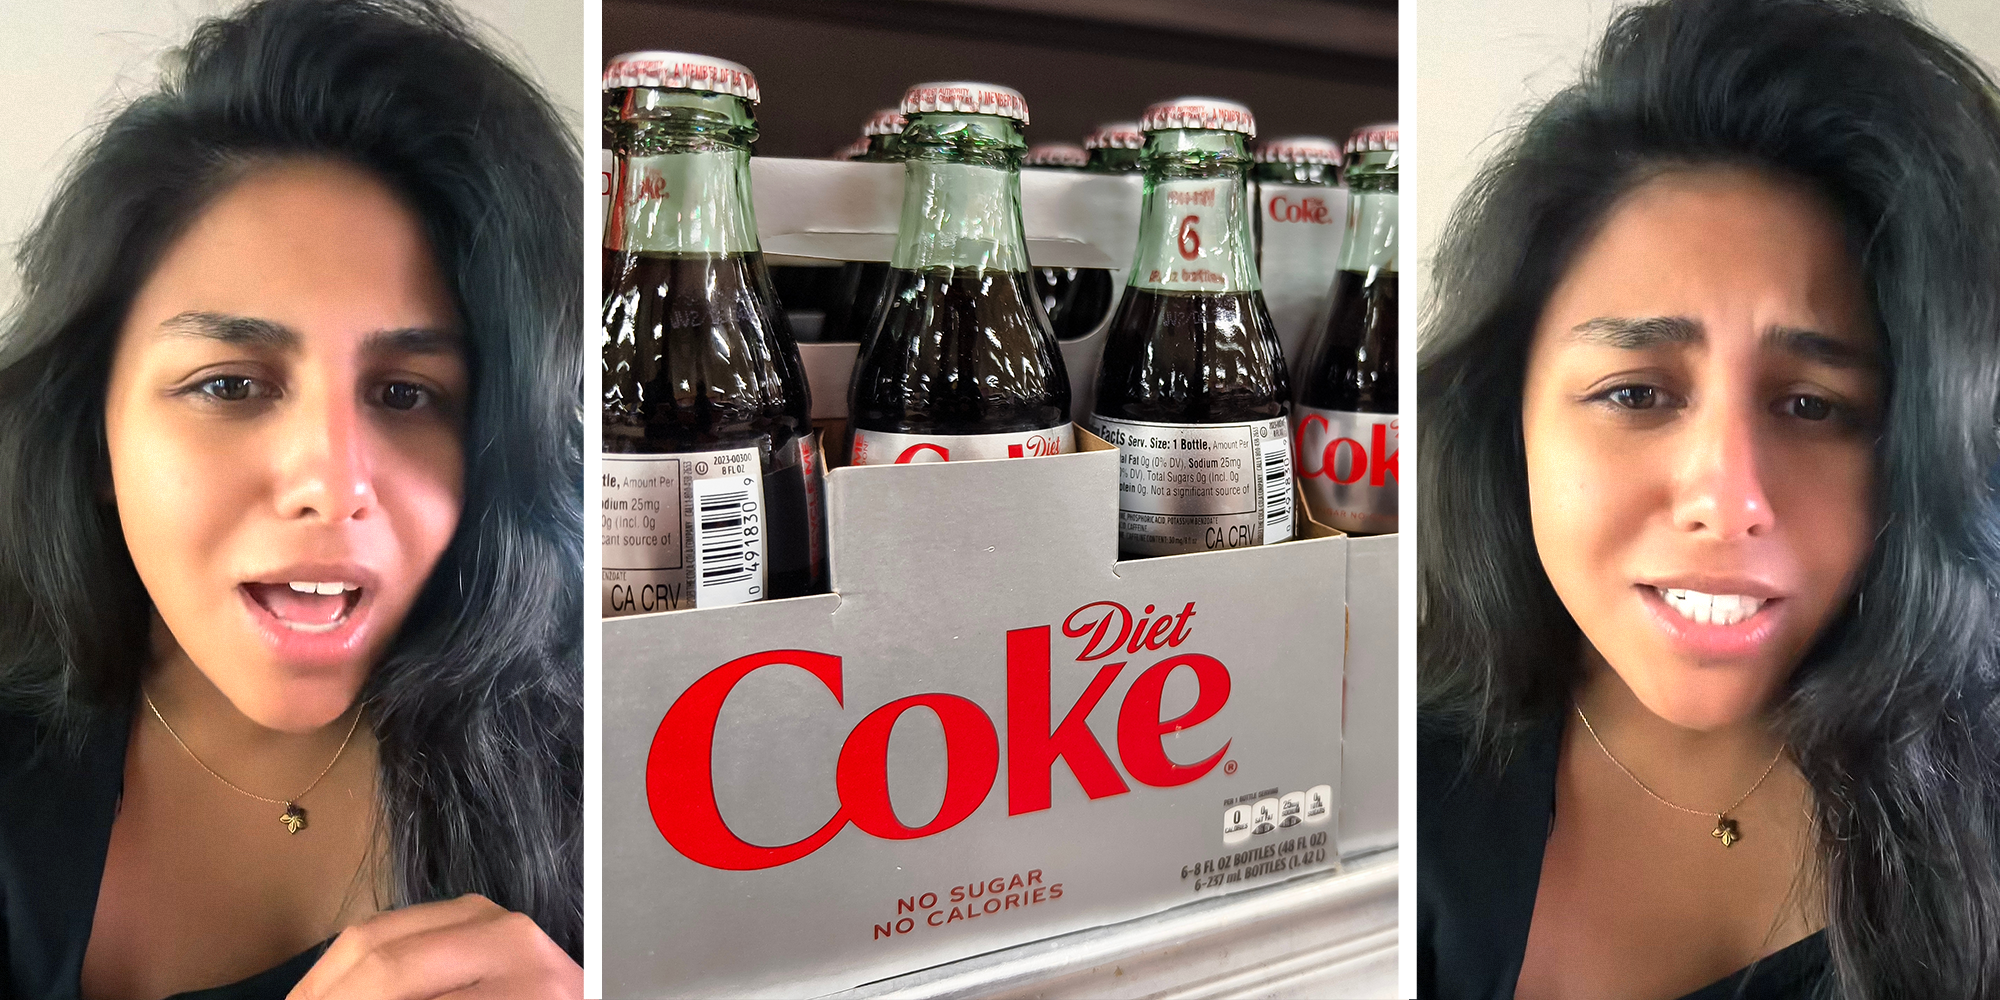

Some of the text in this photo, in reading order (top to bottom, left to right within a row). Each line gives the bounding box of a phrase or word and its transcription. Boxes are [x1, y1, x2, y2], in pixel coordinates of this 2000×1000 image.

[1268, 195, 1329, 224] Coke
[1177, 215, 1201, 262] 6
[1026, 434, 1061, 457] Diet
[1100, 425, 1250, 452] Facts Serv. Size: 1 Bottle, Amount Per
[713, 453, 752, 465] 2023-00300
[721, 466, 727, 475] 8
[728, 465, 736, 475] FL
[801, 441, 813, 476] ME
[1129, 454, 1140, 466] Fat
[1141, 455, 1150, 469] 0g
[1152, 456, 1168, 469] (0%
[1188, 457, 1219, 469] Sodium
[1220, 456, 1242, 470] 25mg
[623, 476, 657, 488] Amount
[660, 475, 675, 488] Per
[1137, 483, 1149, 497] 0g.
[1150, 485, 1165, 496] Not
[1166, 487, 1172, 496] a
[1172, 484, 1214, 498] significant
[1215, 485, 1241, 496] source
[1242, 483, 1250, 495] of
[1147, 470, 1166, 482] Total
[1167, 470, 1195, 484] Sugars
[1196, 471, 1207, 485] 0g
[1208, 471, 1228, 484] (Incl.
[1229, 471, 1240, 484] 0g
[631, 497, 660, 514] 25mg
[615, 515, 640, 530] (Incl.
[642, 515, 656, 531] 0g
[741, 477, 760, 594] 0 491830 9
[1205, 523, 1257, 549] CA CRV
[623, 535, 658, 546] source
[660, 532, 671, 546] of
[611, 583, 681, 612] CA CRV
[1061, 600, 1198, 661] Diet
[645, 624, 1233, 871] Coke
[1233, 810, 1241, 825] 0
[1181, 831, 1328, 879] 6-8 FL OZ BOTTLES (48 FL OZ)
[1194, 873, 1225, 892] 6-237
[1226, 871, 1242, 884] mL
[1244, 858, 1287, 880] BOTTLES
[1316, 848, 1326, 863] L)
[898, 868, 1043, 915] NO SUGAR
[873, 882, 1065, 941] NO CALORIES
